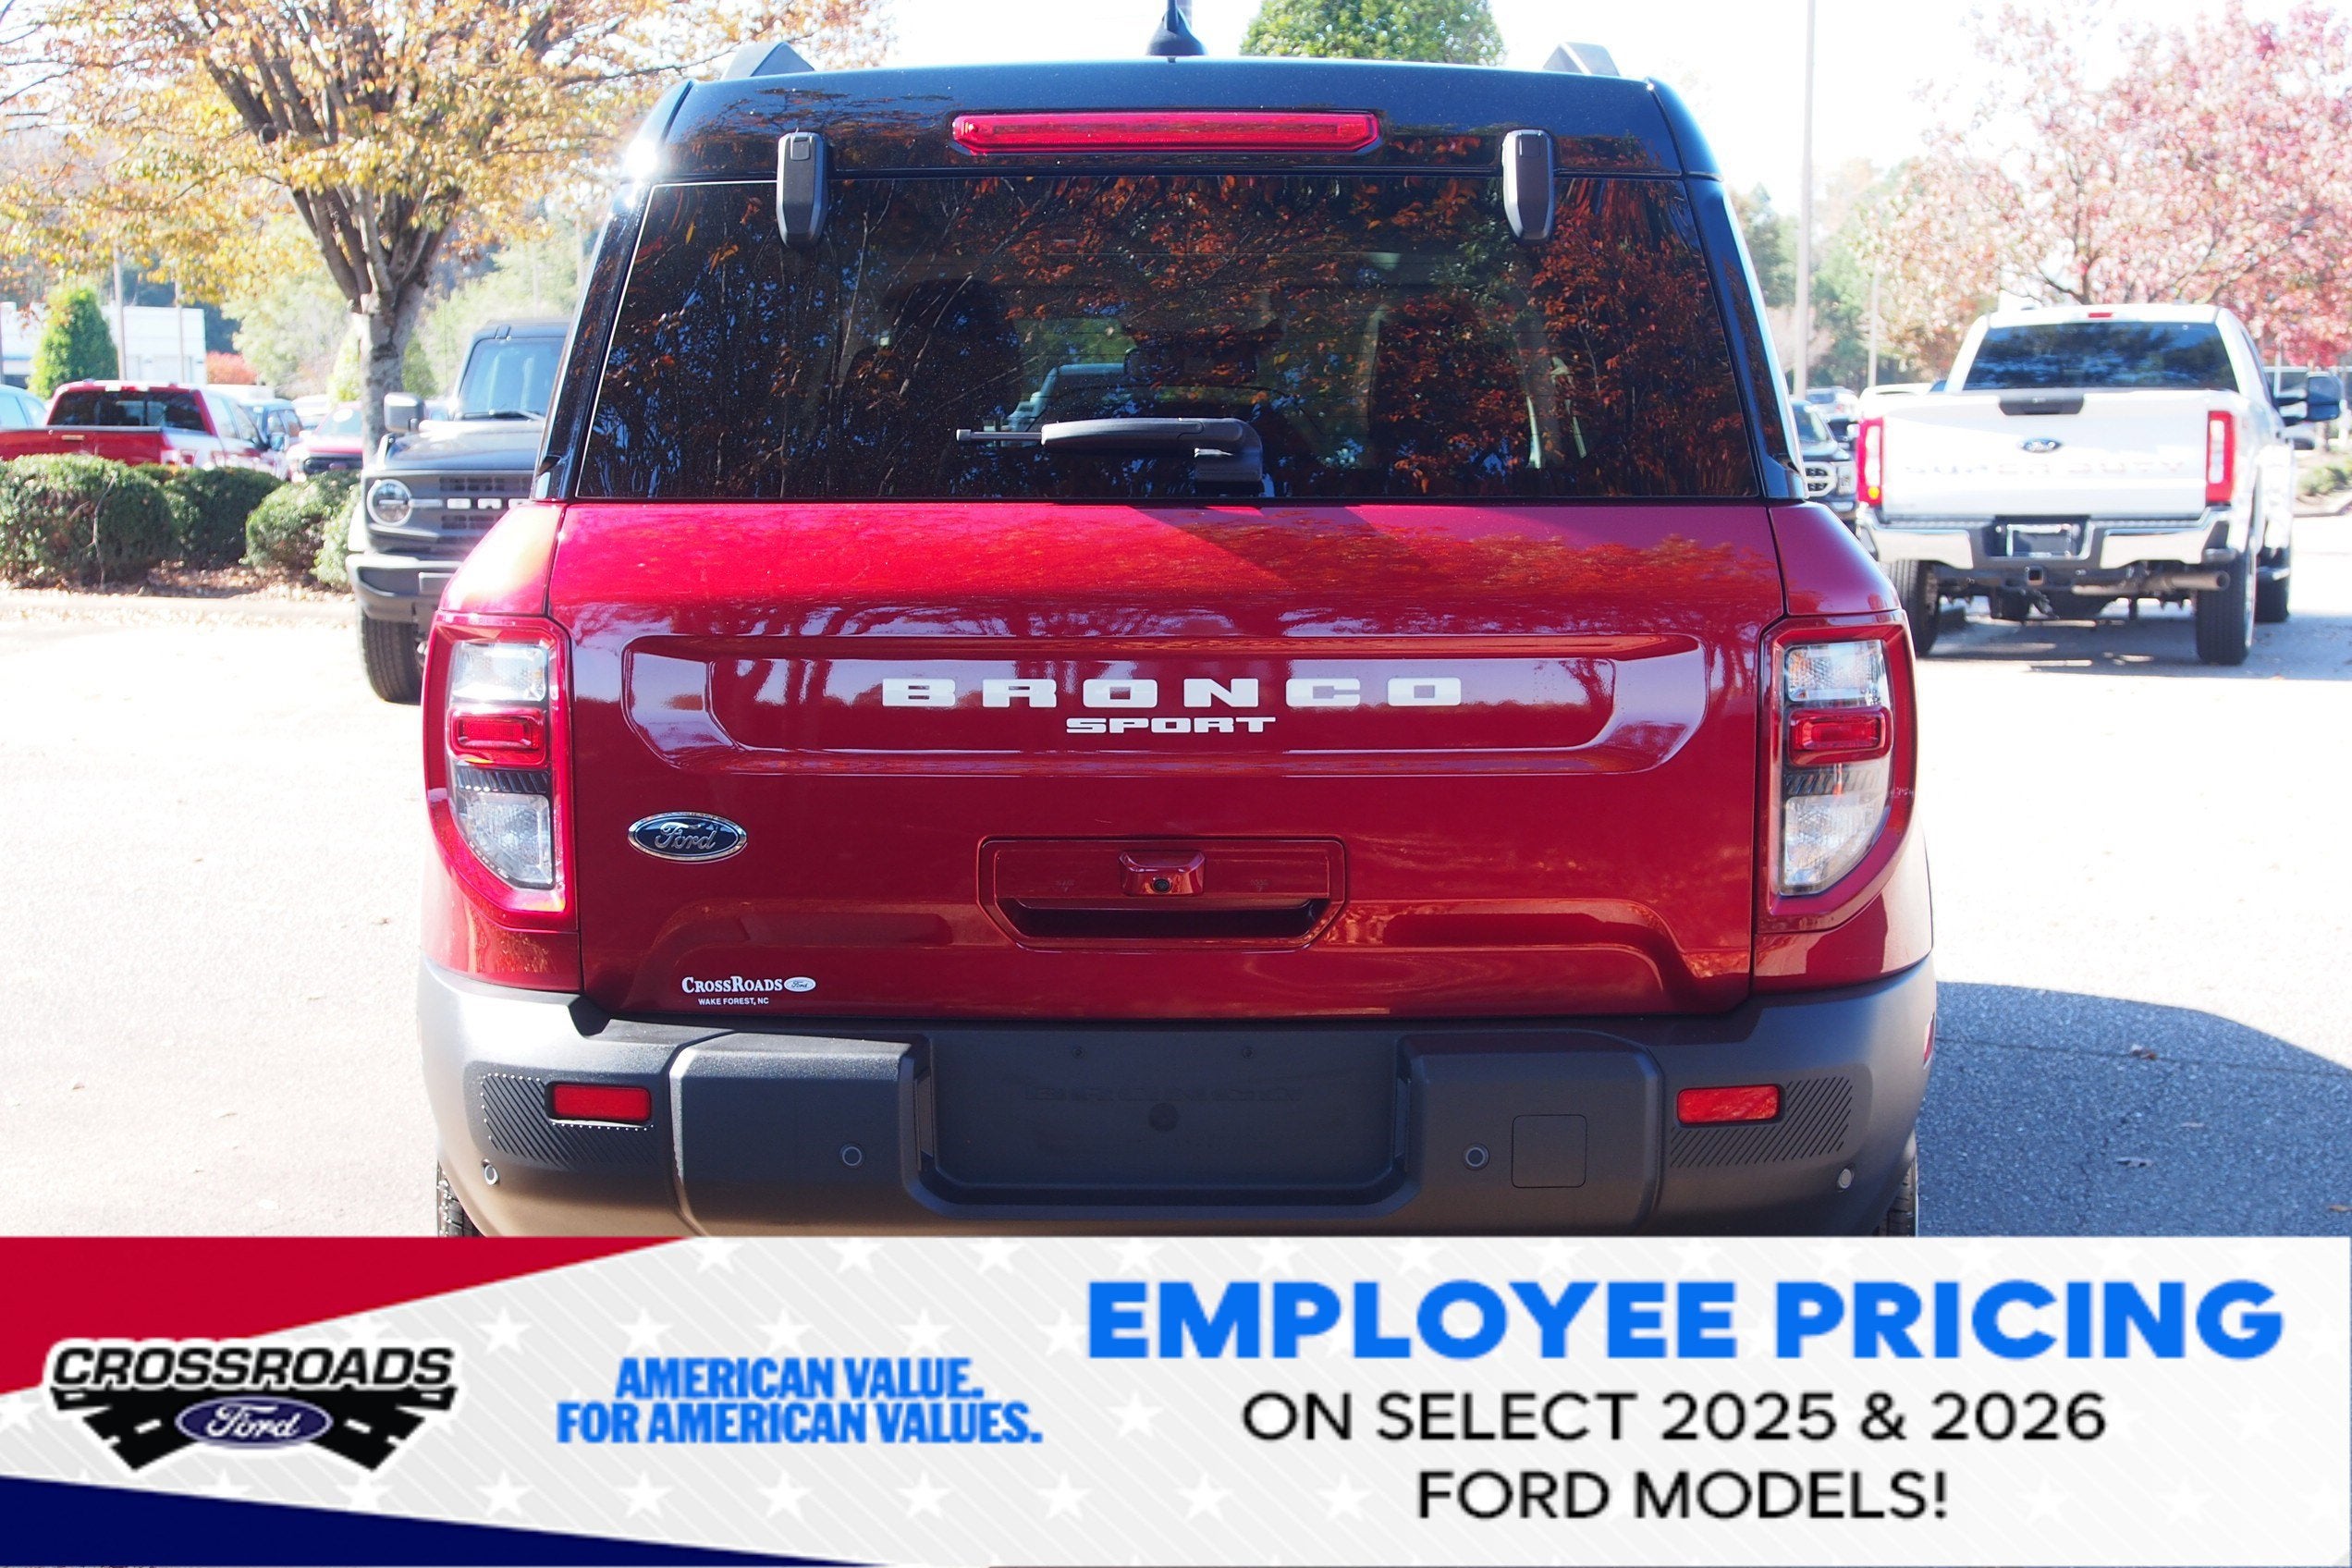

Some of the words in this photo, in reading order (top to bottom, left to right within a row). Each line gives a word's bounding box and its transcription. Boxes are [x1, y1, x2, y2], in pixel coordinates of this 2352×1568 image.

[882, 678, 1462, 708] BRONCO
[1065, 717, 1277, 734] SPORT
[655, 821, 717, 851] Ford
[698, 998, 721, 1006] WAKE
[723, 997, 756, 1006] FOREST,
[757, 997, 769, 1005] NC
